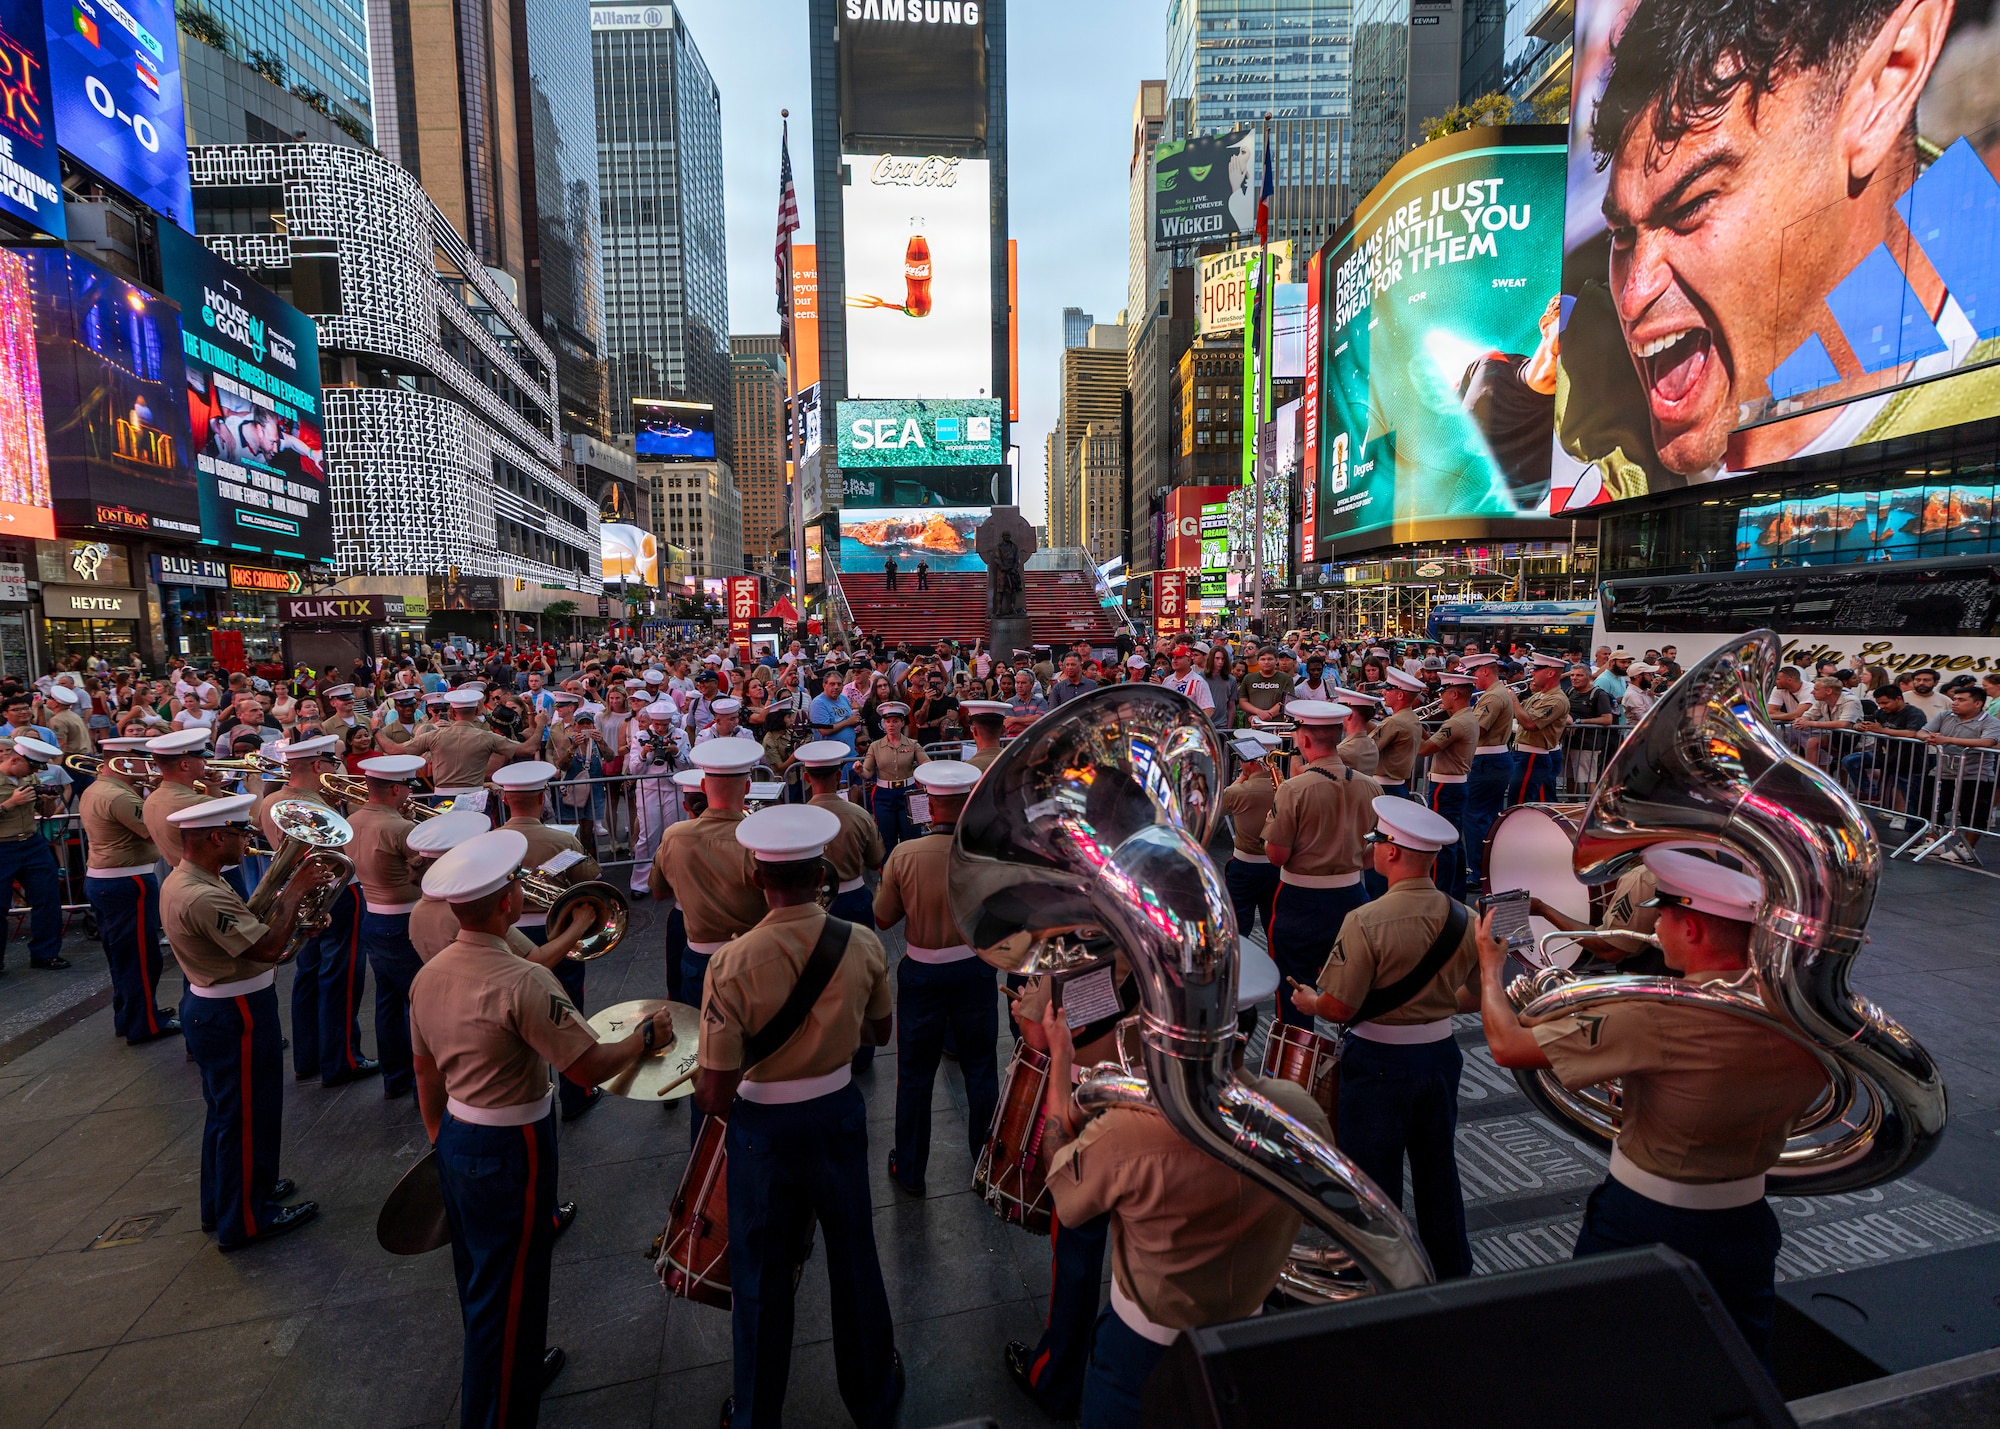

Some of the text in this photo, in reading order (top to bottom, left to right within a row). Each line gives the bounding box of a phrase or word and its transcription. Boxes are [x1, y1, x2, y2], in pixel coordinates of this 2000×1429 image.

[78, 0, 96, 18] OR
[592, 11, 641, 25] Allianz
[846, 0, 979, 26] SAMSUNG
[1413, 17, 1438, 25] KEVANI
[135, 49, 157, 73] CRO
[0, 154, 58, 204] INNING
[870, 152, 963, 188] Coca-Cola
[0, 173, 39, 212] SICAL
[1175, 198, 1186, 206] See
[1160, 205, 1189, 215] Remember
[1161, 214, 1223, 238] WICKED
[1337, 178, 1504, 288] DREAMS ARE JUST
[1204, 251, 1248, 283] LITTLE
[1335, 204, 1531, 311] DREAMS UNTIL YOU
[793, 284, 817, 294] eyon
[1335, 232, 1498, 332] SWEAT FOR THEM
[1491, 278, 1527, 288] SWEAT
[203, 286, 249, 329] HOUSE
[1203, 279, 1246, 324] HORR
[1408, 291, 1427, 304] FOR
[1216, 313, 1246, 324] LittleShop
[215, 314, 253, 348] GOAL
[182, 329, 200, 358] THE
[200, 338, 238, 378] ULTIMATE
[238, 358, 267, 392] SOCCER
[266, 373, 281, 400] FAN
[280, 379, 316, 415] EXPERIENCE
[1305, 303, 1319, 452] HERSHEY'S STORE
[852, 418, 926, 449] SEA
[1353, 461, 1375, 478] Degree
[97, 505, 123, 524] LOST
[124, 510, 149, 530] BOYS
[159, 519, 179, 530] PALACE
[179, 521, 200, 534] THEATRE
[1166, 518, 1179, 542] FIVE
[2, 564, 20, 572] Shop
[160, 555, 226, 577] BLUE FIN
[1, 576, 27, 584] LUGG
[233, 568, 290, 589] DOS CAMINOS
[8, 585, 16, 597] 3
[735, 579, 755, 619] tkts
[1161, 574, 1181, 615] tkts
[71, 596, 121, 611] HEYTEA
[290, 600, 372, 618] KLIKTIX
[384, 601, 426, 617] TICKET CENTER
[1252, 681, 1280, 690] adidas
[1477, 1118, 1597, 1184] EUGENE
[1775, 1212, 1934, 1283] BARRYM
